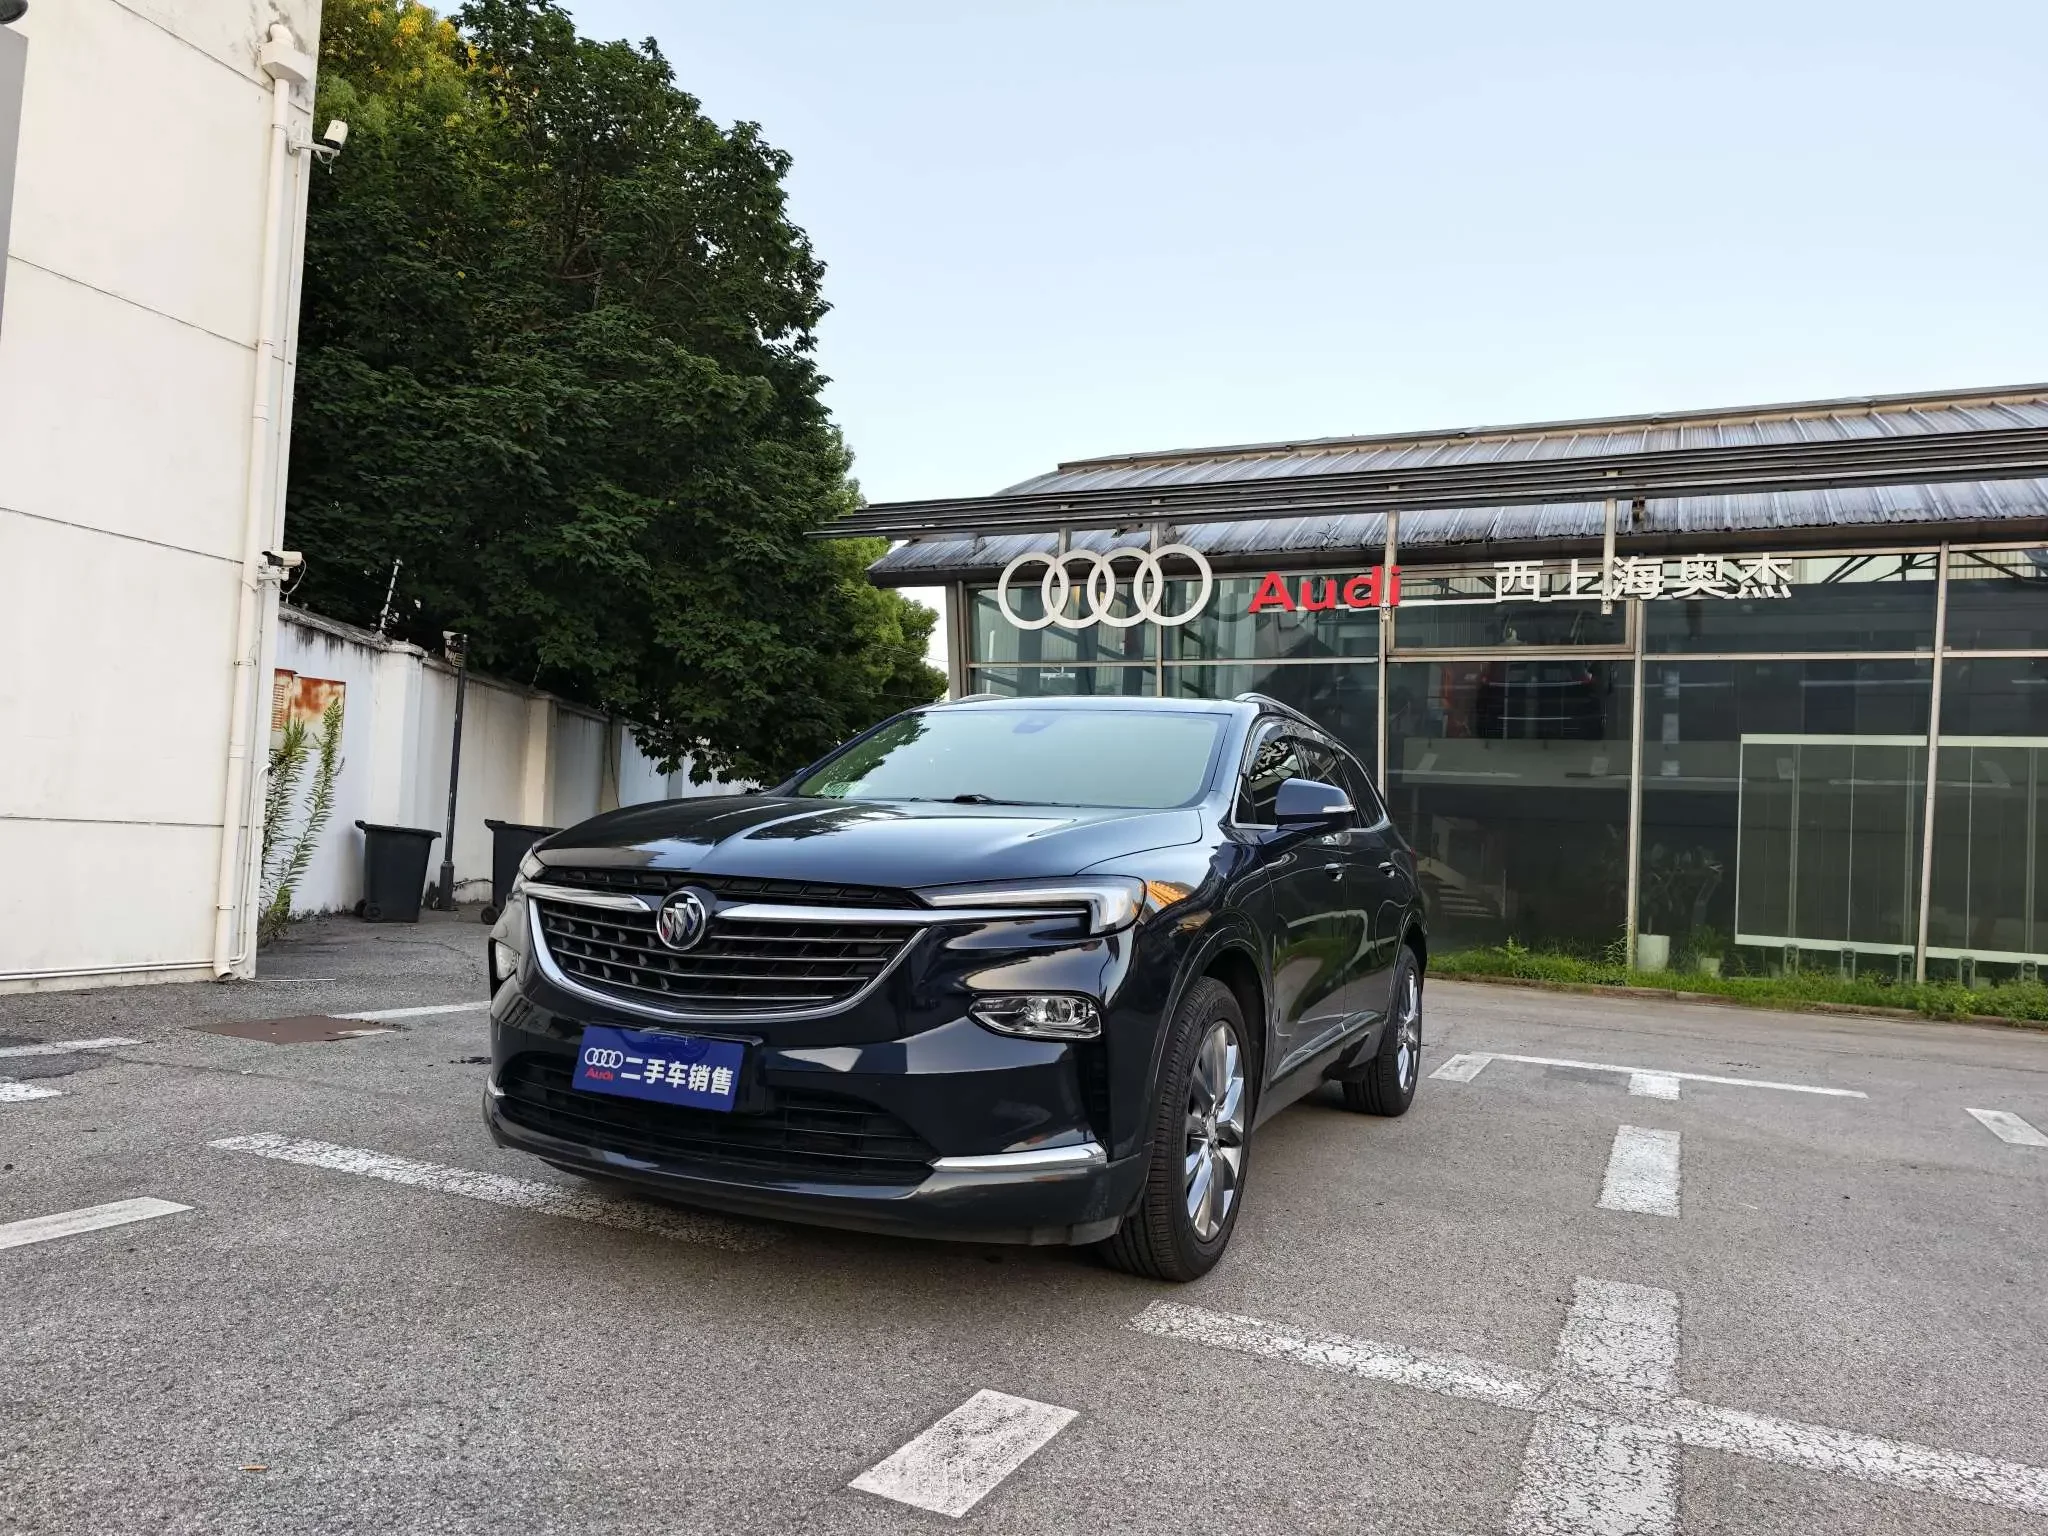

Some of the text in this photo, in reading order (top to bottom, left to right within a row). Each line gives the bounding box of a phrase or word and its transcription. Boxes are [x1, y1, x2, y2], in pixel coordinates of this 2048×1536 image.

[1248, 566, 1401, 613] Audi
[1494, 553, 1793, 602] 西上海奥杰
[585, 1067, 614, 1081] Audi
[621, 1056, 733, 1095] 二手车销售
